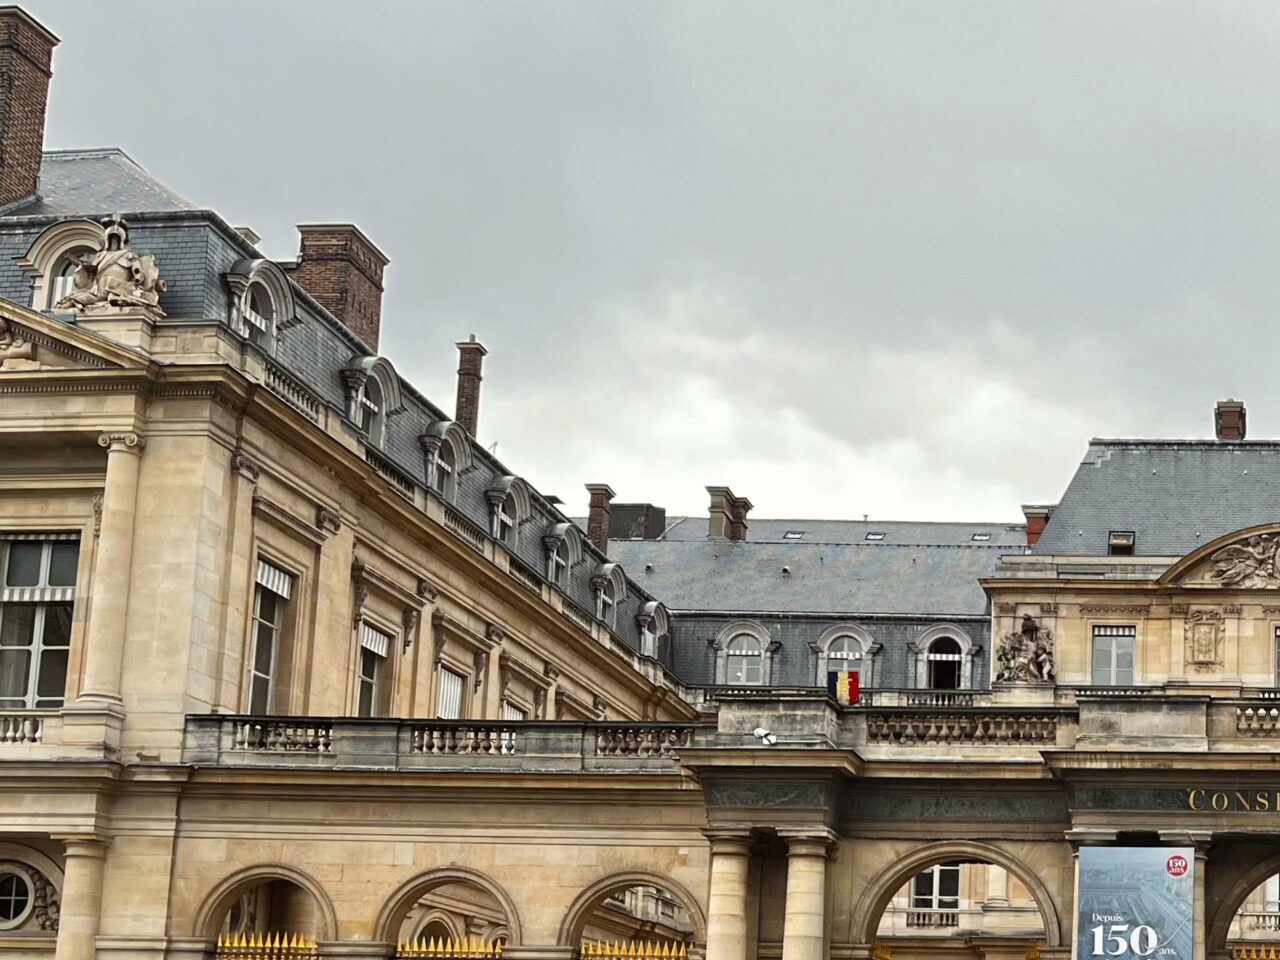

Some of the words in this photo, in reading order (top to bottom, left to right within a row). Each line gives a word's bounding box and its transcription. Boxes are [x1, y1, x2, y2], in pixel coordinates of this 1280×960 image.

[1169, 858, 1185, 867] 150
[1092, 912, 1123, 923] Depuis
[1091, 924, 1158, 956] 150
